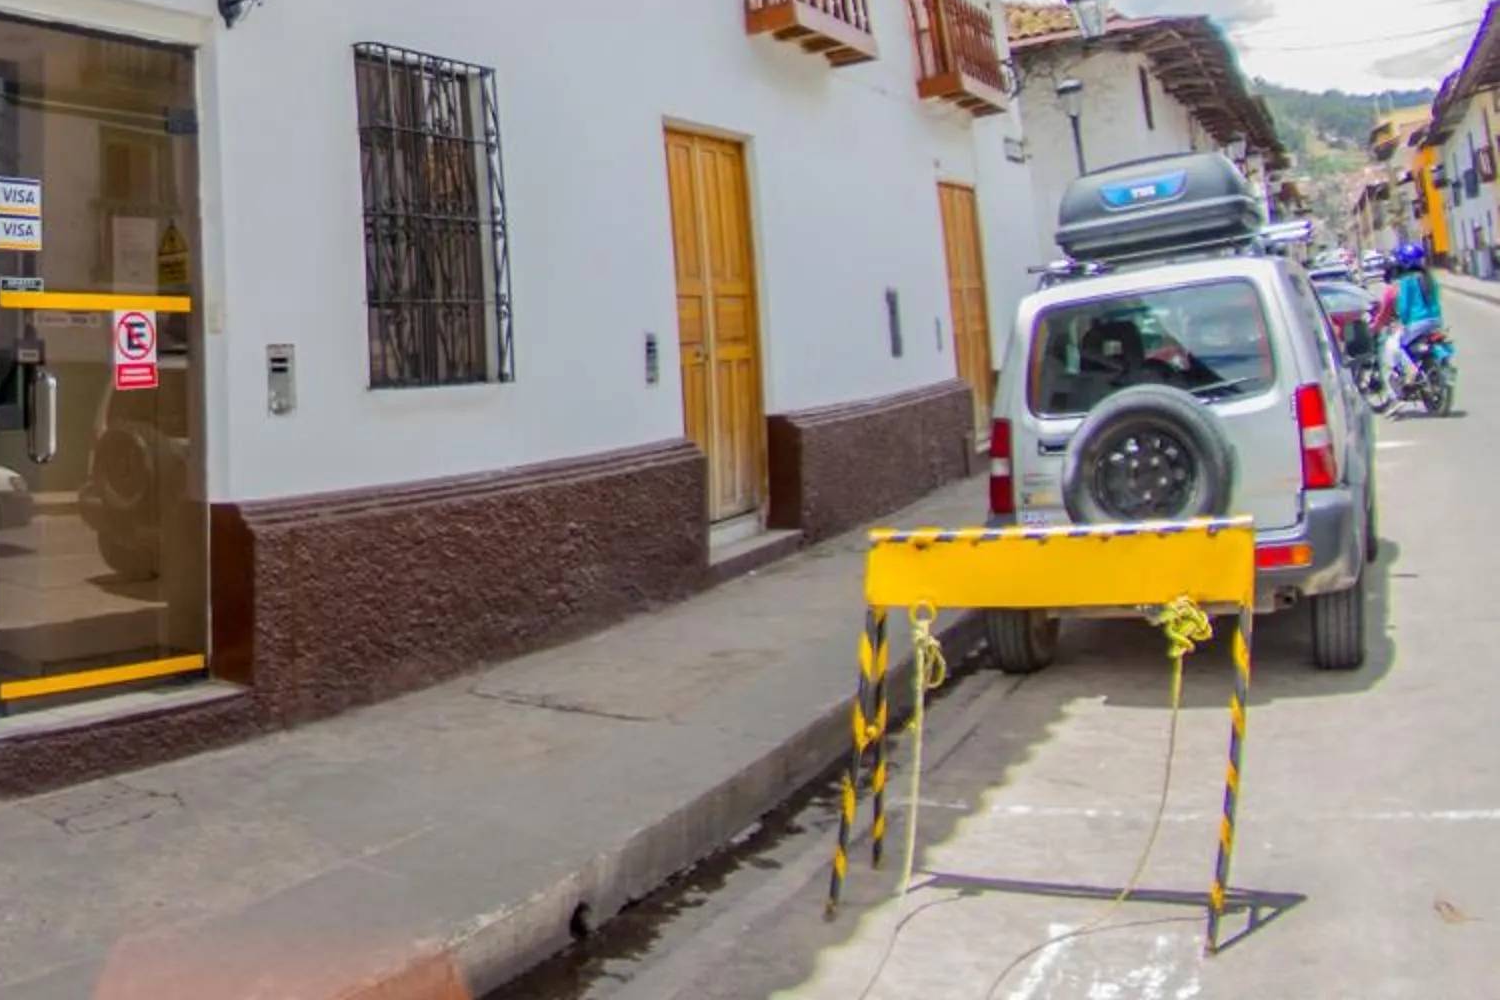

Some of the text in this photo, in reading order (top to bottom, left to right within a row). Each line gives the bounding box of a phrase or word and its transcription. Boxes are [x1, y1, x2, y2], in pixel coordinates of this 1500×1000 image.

[3, 187, 36, 204] VISA
[3, 222, 35, 237] VISA
[126, 321, 147, 350] E
